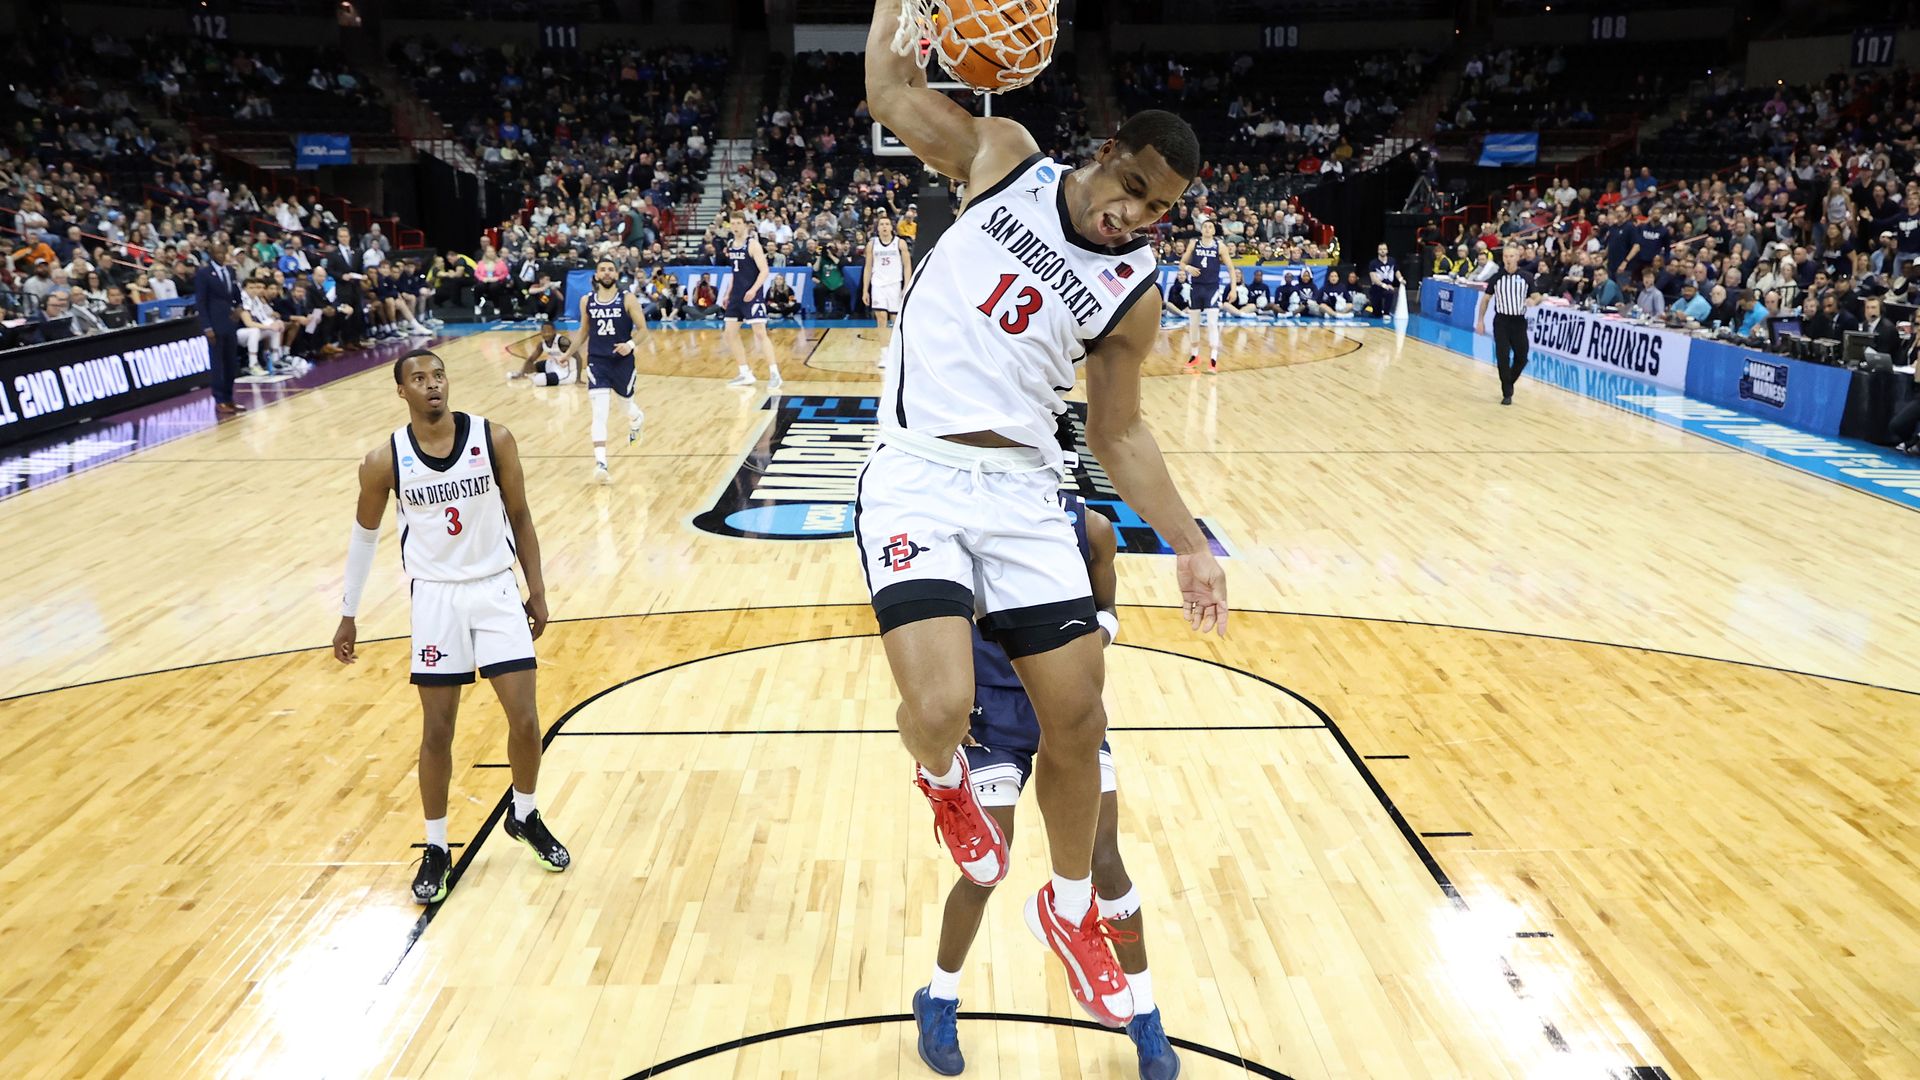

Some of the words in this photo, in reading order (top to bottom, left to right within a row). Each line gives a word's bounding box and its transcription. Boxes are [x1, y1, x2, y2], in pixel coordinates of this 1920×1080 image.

[193, 15, 227, 39] 112
[545, 26, 576, 47] 111
[1265, 26, 1298, 47] 109
[1592, 16, 1626, 39] 108
[1857, 36, 1892, 63] 107
[881, 258, 890, 266] 25
[1196, 249, 1217, 258] YALE
[1201, 256, 1208, 268] 4
[733, 259, 740, 272] 1
[981, 206, 1024, 245] SAN
[1007, 229, 1065, 282] DIEGO
[1051, 269, 1103, 326] STATE
[589, 308, 622, 318] YALE
[976, 274, 1043, 334] 13
[597, 319, 616, 336] 24
[1534, 308, 1585, 354] SECOND
[1587, 321, 1663, 377] ROUNDS
[1750, 361, 1775, 383] MARCH
[14, 370, 64, 419] 2ND
[59, 355, 129, 406] ROUND
[1753, 379, 1786, 403] MADNESS
[405, 486, 429, 506] SAN
[426, 481, 460, 504] DIEGO
[460, 475, 490, 498] STATE
[445, 507, 462, 536] 3
